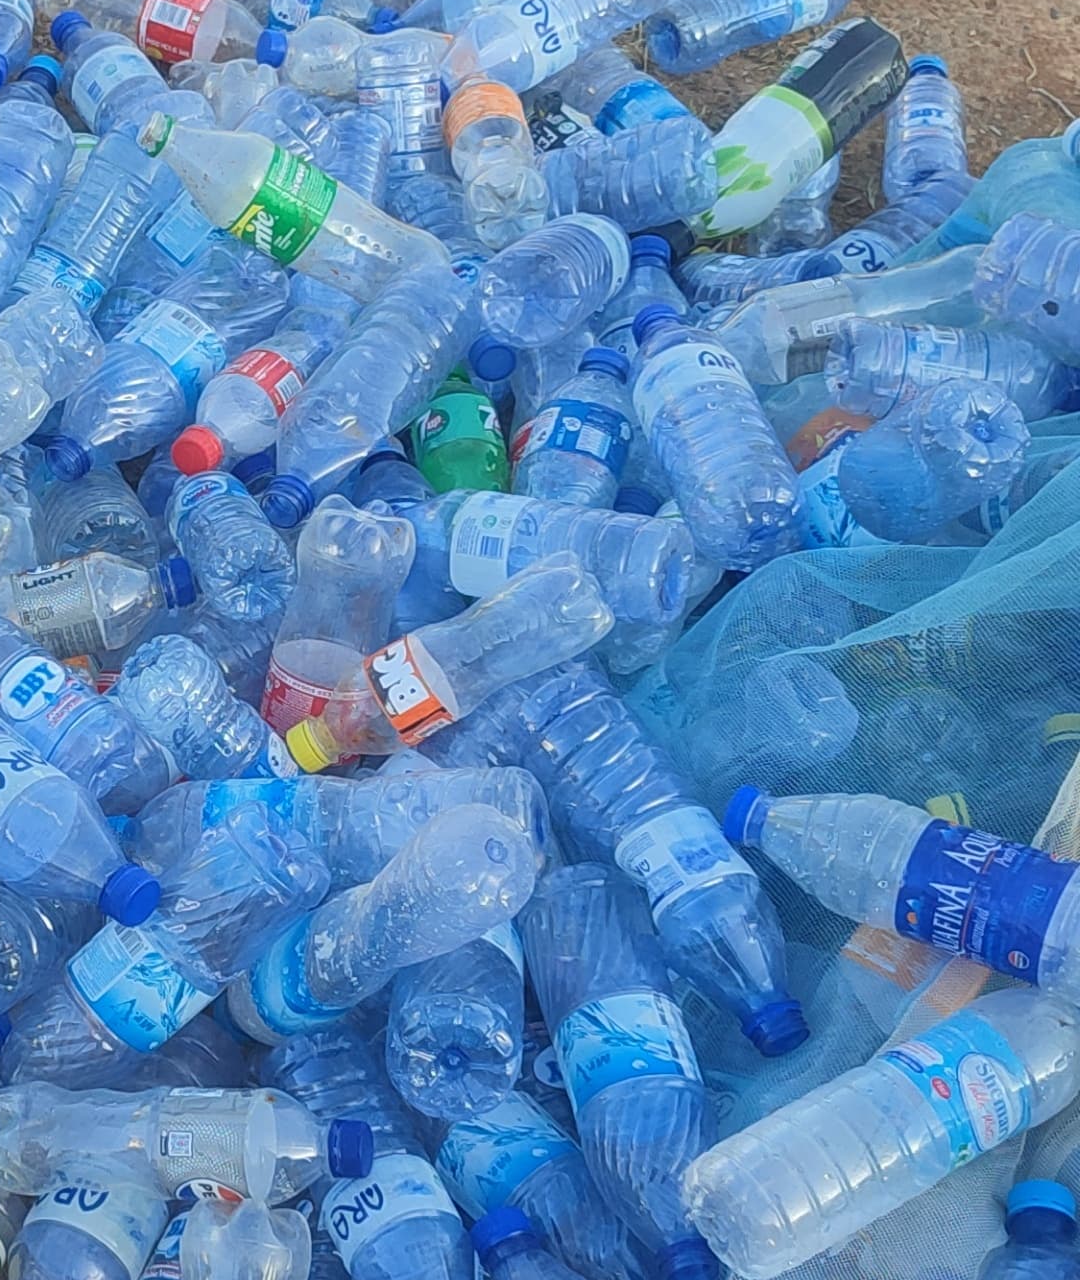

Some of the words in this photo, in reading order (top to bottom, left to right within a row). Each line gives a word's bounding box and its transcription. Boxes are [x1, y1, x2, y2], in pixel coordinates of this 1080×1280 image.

[842, 239, 889, 275] RA
[697, 349, 738, 372] AR
[22, 569, 76, 590] LIGHT
[8, 660, 63, 709] BBY
[329, 1182, 385, 1242] ARA
